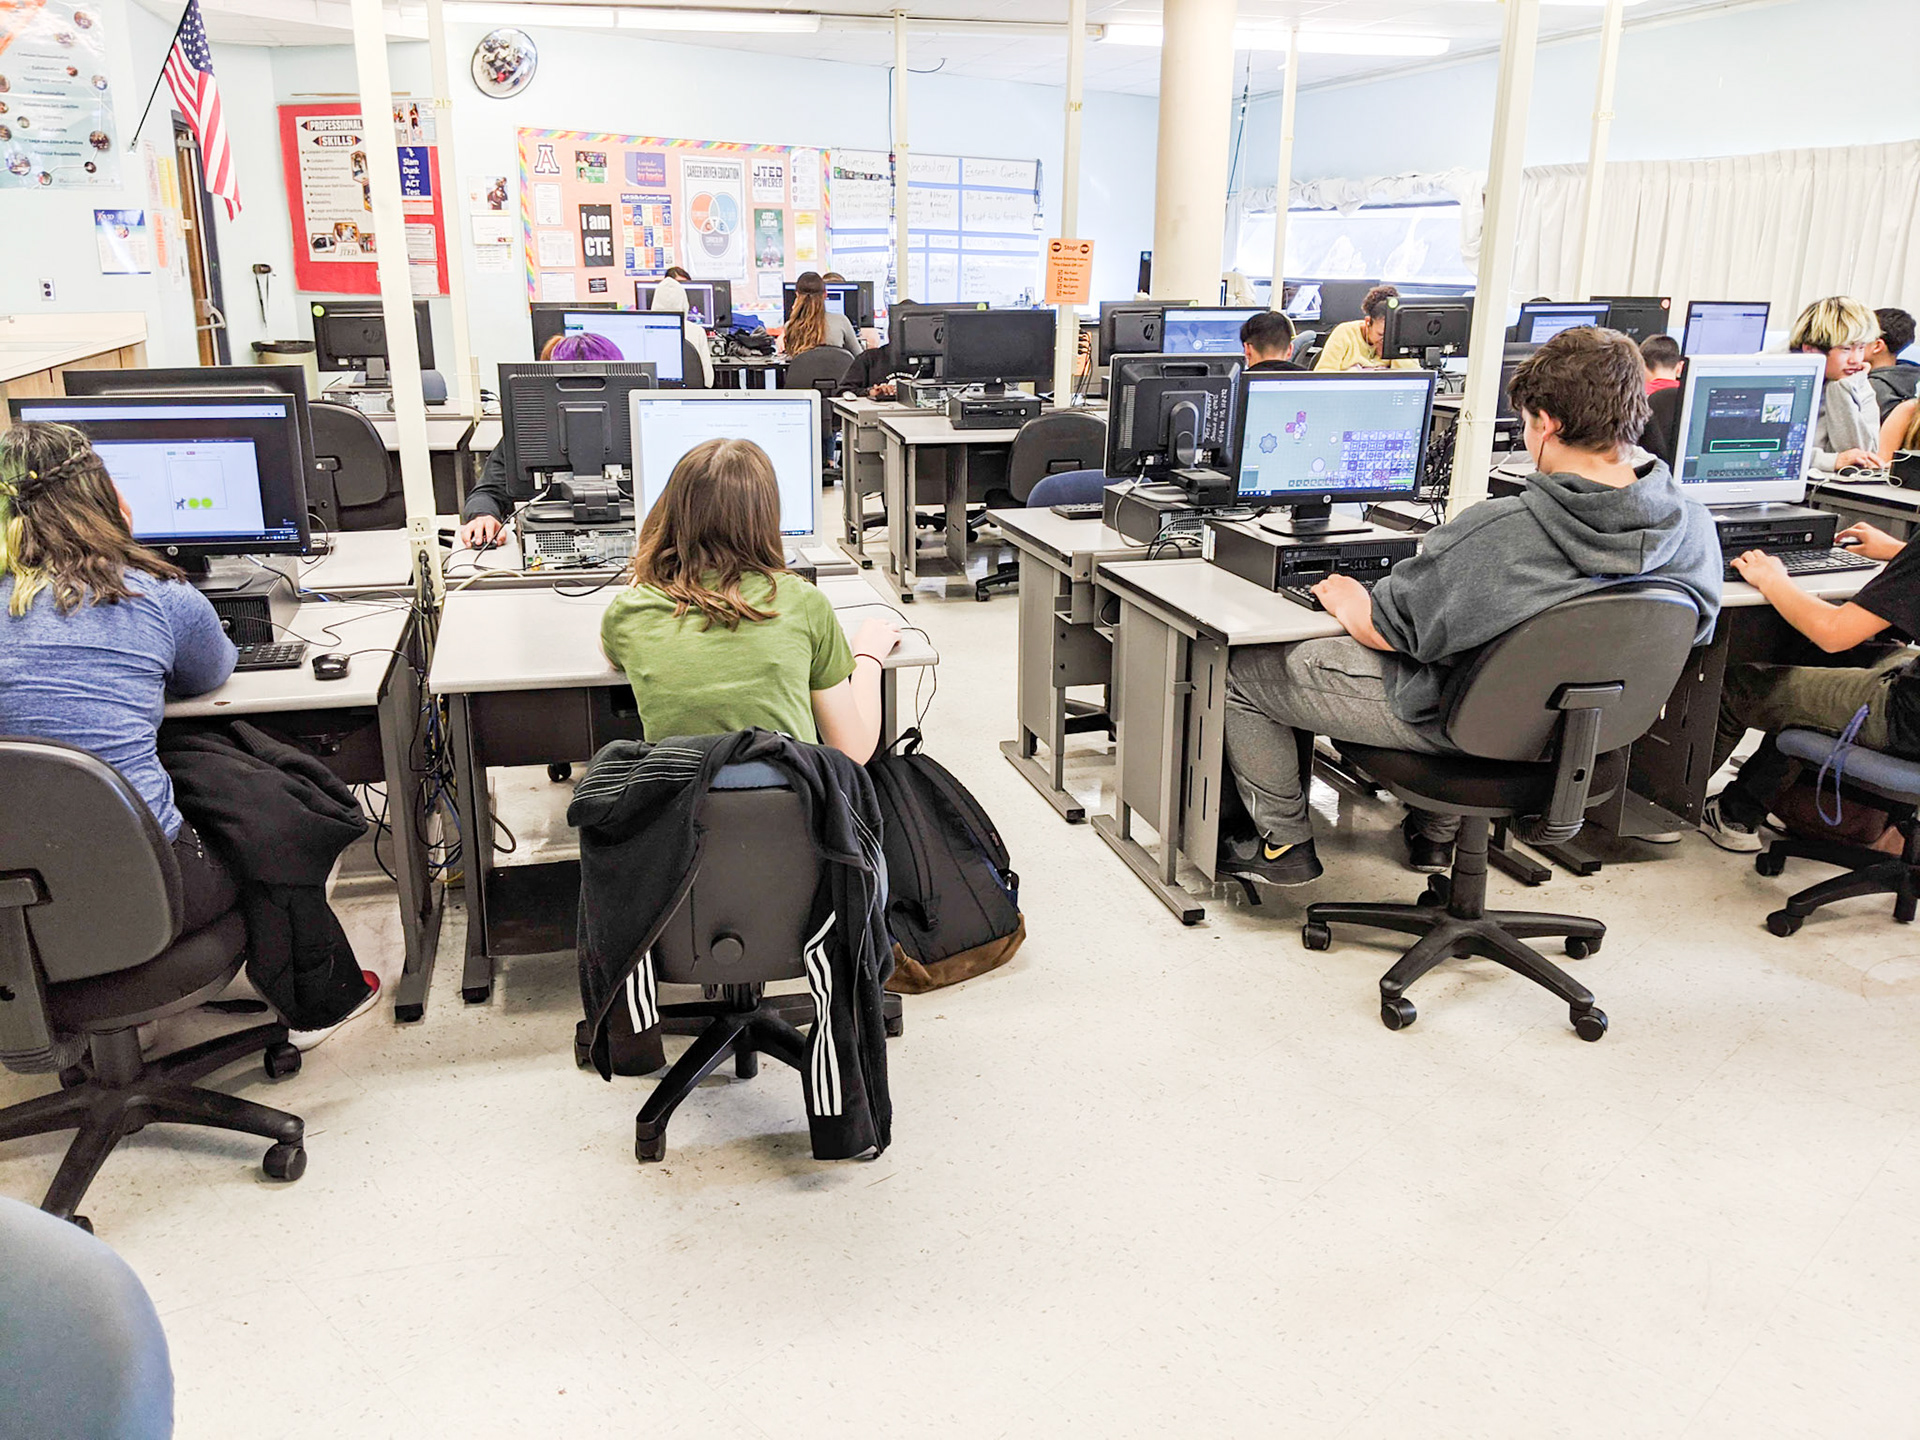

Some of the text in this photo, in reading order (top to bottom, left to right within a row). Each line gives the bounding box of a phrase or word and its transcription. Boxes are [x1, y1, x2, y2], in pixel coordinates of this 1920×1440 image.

[310, 119, 361, 130] PROFESSIONAL
[321, 135, 353, 146] SKILLS
[402, 158, 419, 166] Slam
[534, 143, 561, 174] A
[402, 166, 420, 174] Dunk
[687, 165, 739, 180] CAREER DRIVEN EDUCATION
[753, 165, 783, 178] JTED
[753, 177, 783, 188] POWERED
[581, 212, 611, 230] I am
[584, 236, 612, 257] CTE
